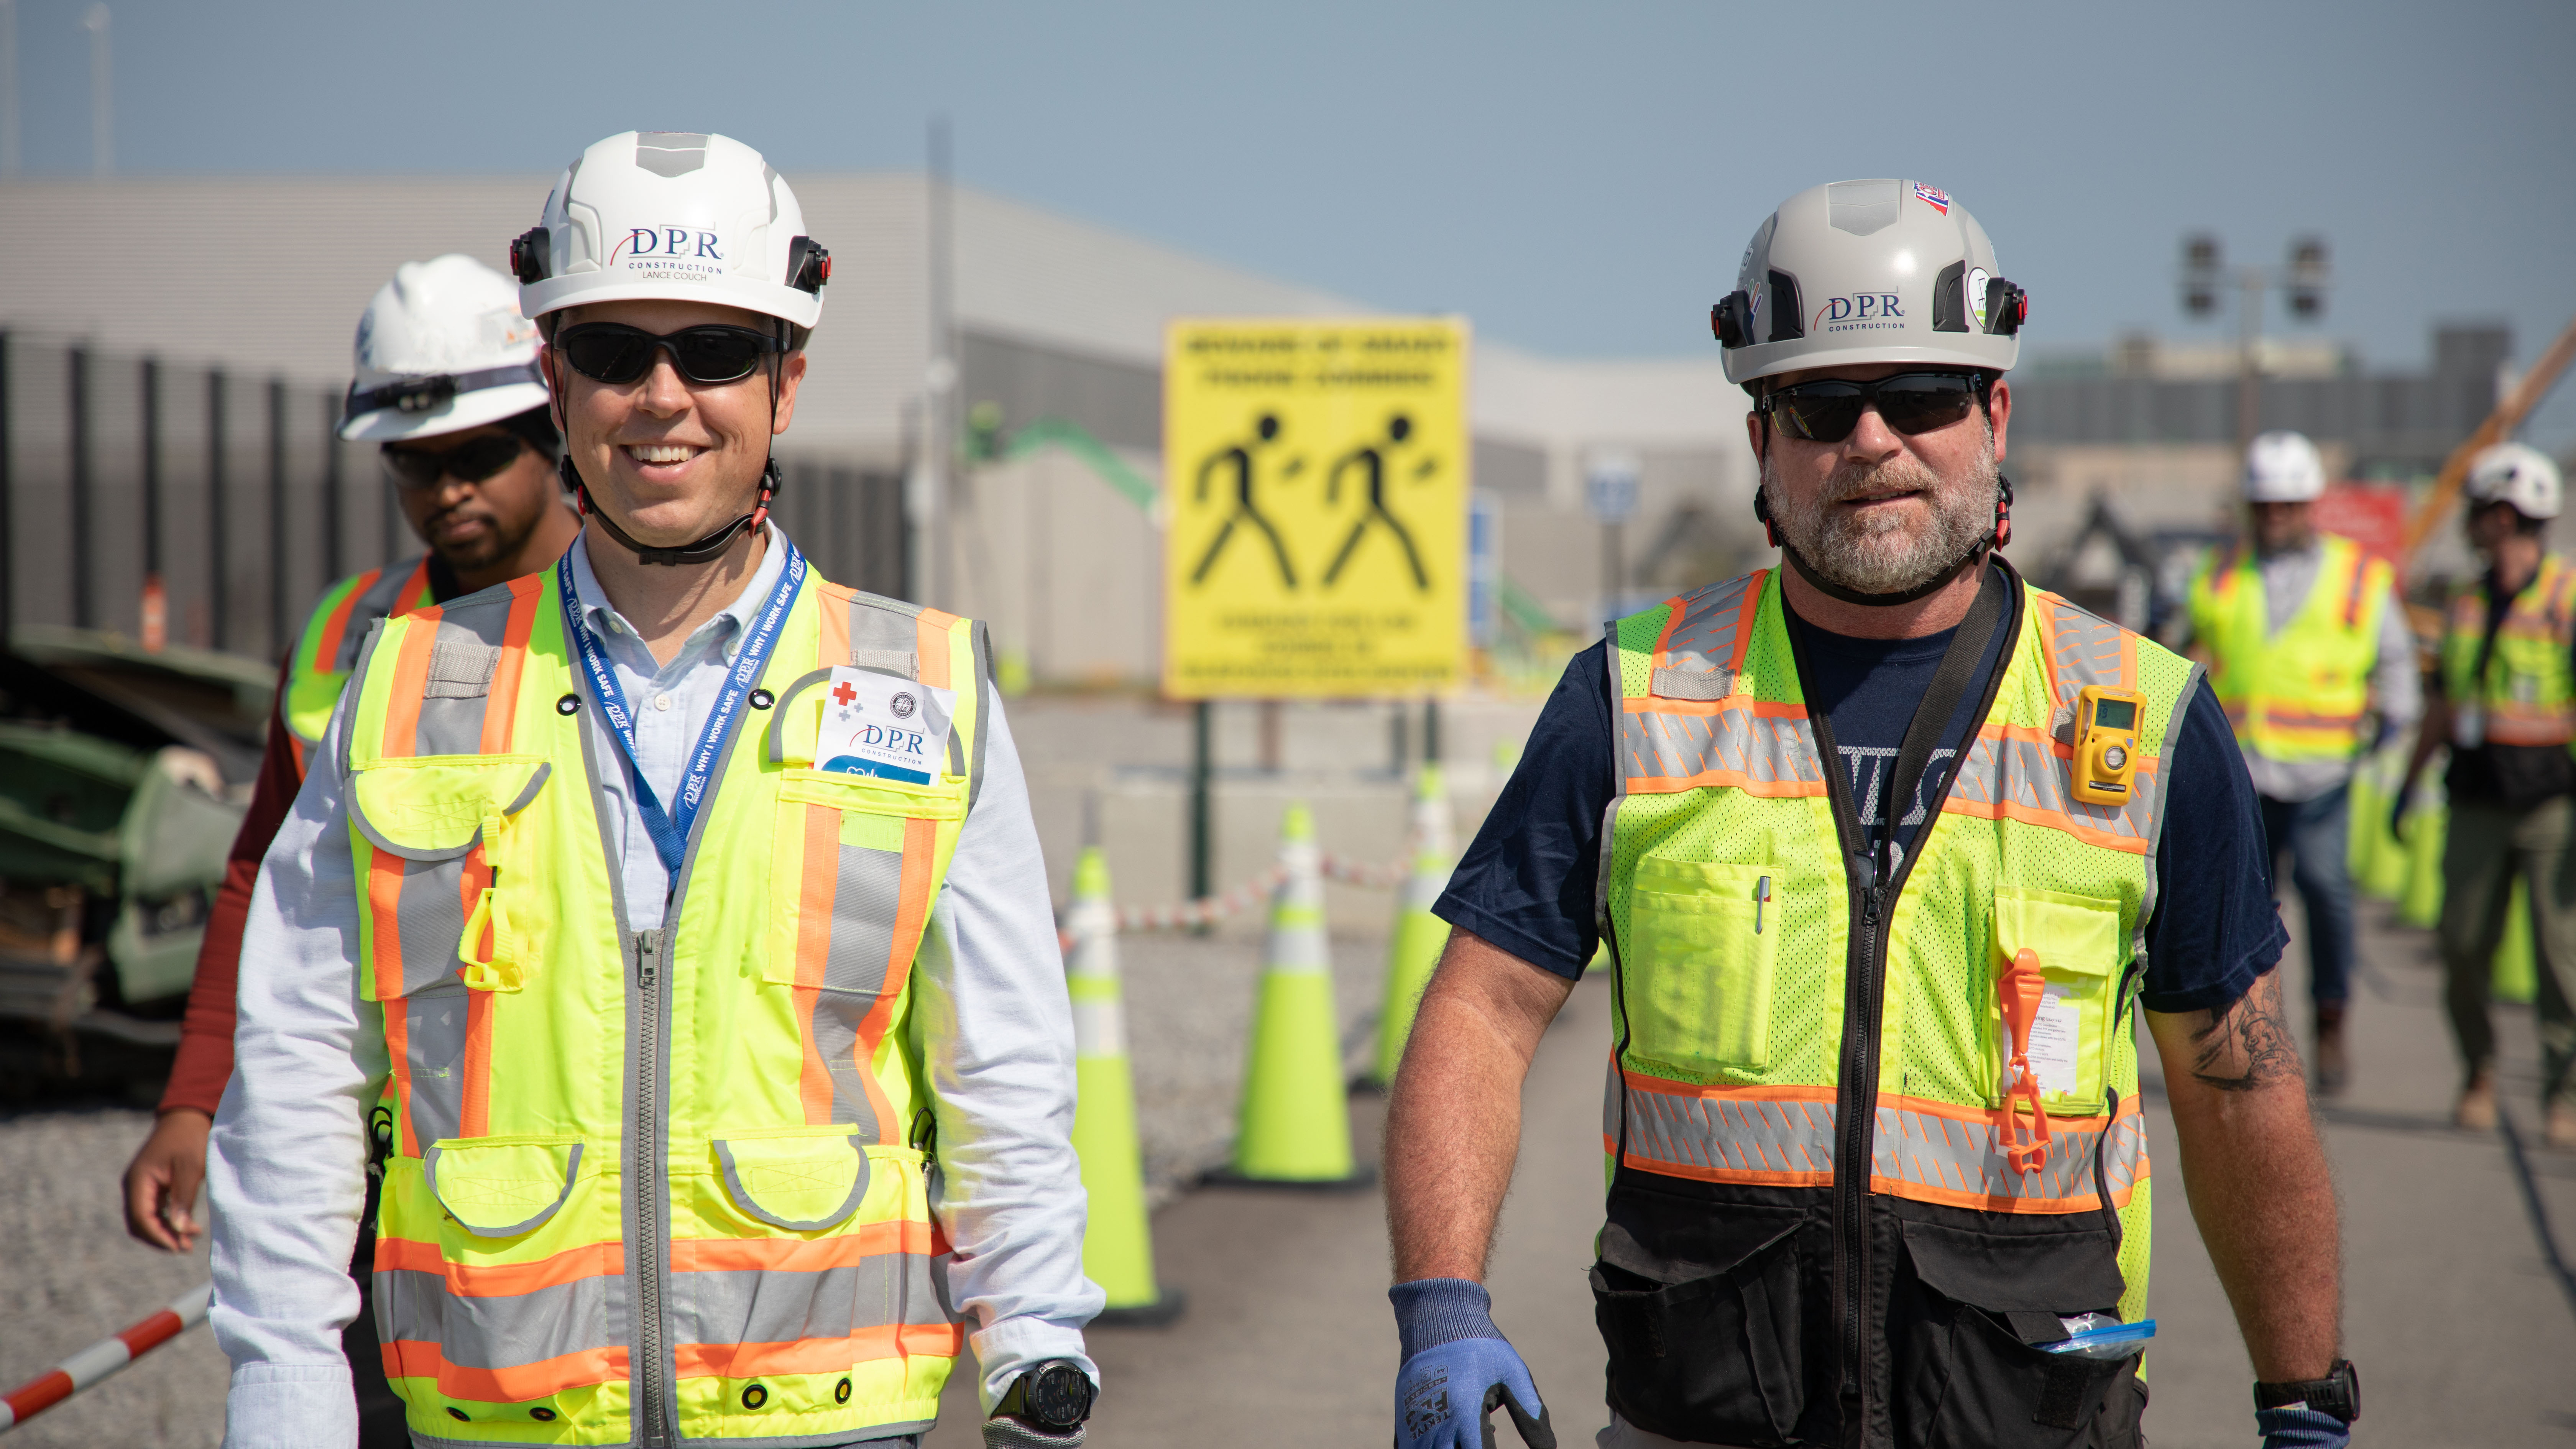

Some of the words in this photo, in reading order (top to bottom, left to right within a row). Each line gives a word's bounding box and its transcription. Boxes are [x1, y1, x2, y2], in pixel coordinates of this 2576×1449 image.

[629, 228, 722, 260] DPR
[629, 262, 722, 274] CONSTRUCTION
[642, 271, 671, 279] LANCE
[674, 272, 706, 281] COUCH
[1829, 295, 1904, 320] DPR
[1829, 323, 1905, 332] CONSTRUCTION
[789, 554, 800, 578] DPR
[564, 571, 573, 595] SAFE
[567, 605, 577, 628] CONSTRUCTION
[571, 598, 583, 625] DPR
[748, 635, 765, 656] WHY
[761, 605, 782, 632] WORK
[776, 582, 792, 606] SAFE
[579, 623, 590, 642] WHY
[586, 647, 603, 675] WORK
[597, 674, 614, 698] SAFE
[735, 658, 756, 683] DPR
[745, 660, 759, 683] CONSTRUCTION
[605, 707, 619, 729] CONSTRUCTION
[610, 705, 629, 728] DPR
[695, 749, 711, 772] WHY
[707, 715, 728, 743] WORK
[721, 689, 738, 714] SAFE
[863, 724, 923, 755] DPR
[861, 748, 922, 765] CONSTRUCTION
[684, 775, 702, 803] DPR
[693, 776, 706, 804] CONSTRUCTION
[1412, 1411, 1451, 1441] TEKTYE
